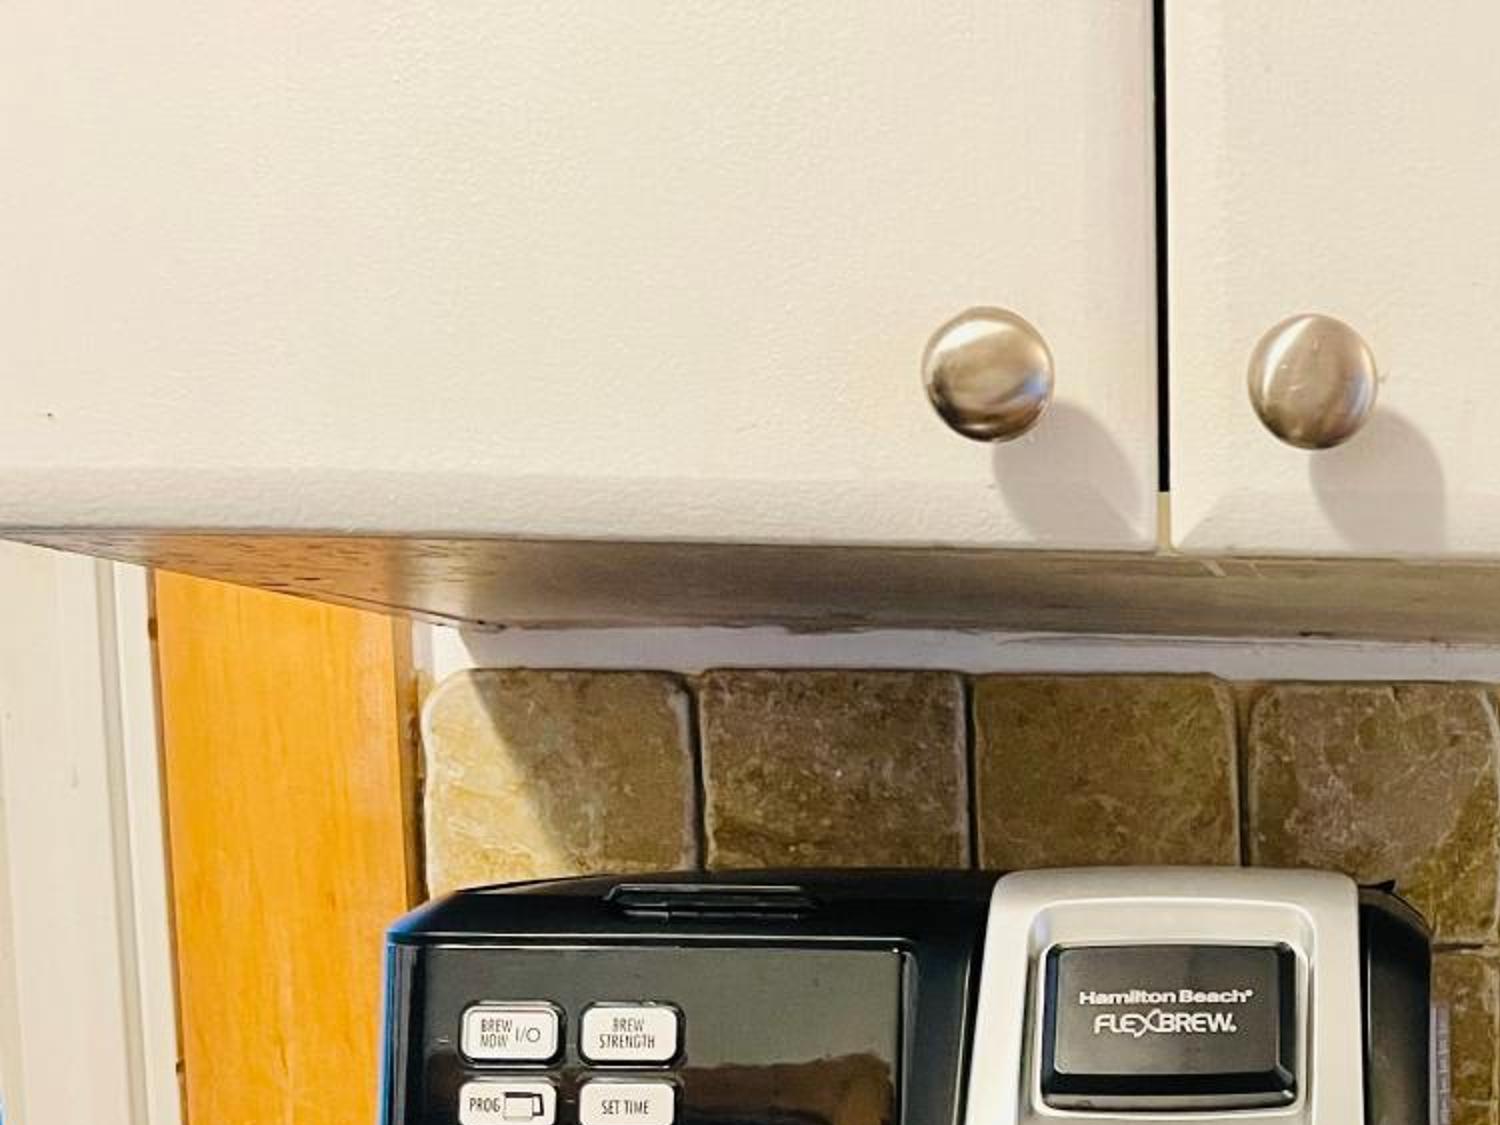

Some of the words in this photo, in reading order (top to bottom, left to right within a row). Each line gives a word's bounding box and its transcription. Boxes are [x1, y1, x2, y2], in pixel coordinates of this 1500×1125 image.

[1079, 989, 1176, 1005] Hamilton
[481, 1018, 513, 1033] BREW
[612, 1018, 645, 1032] BREW
[480, 1033, 509, 1048] NOW
[599, 1034, 656, 1049] STRENGTH
[469, 1097, 501, 1112] PROG
[601, 1100, 620, 1115] SET
[625, 1100, 649, 1115] TIME
